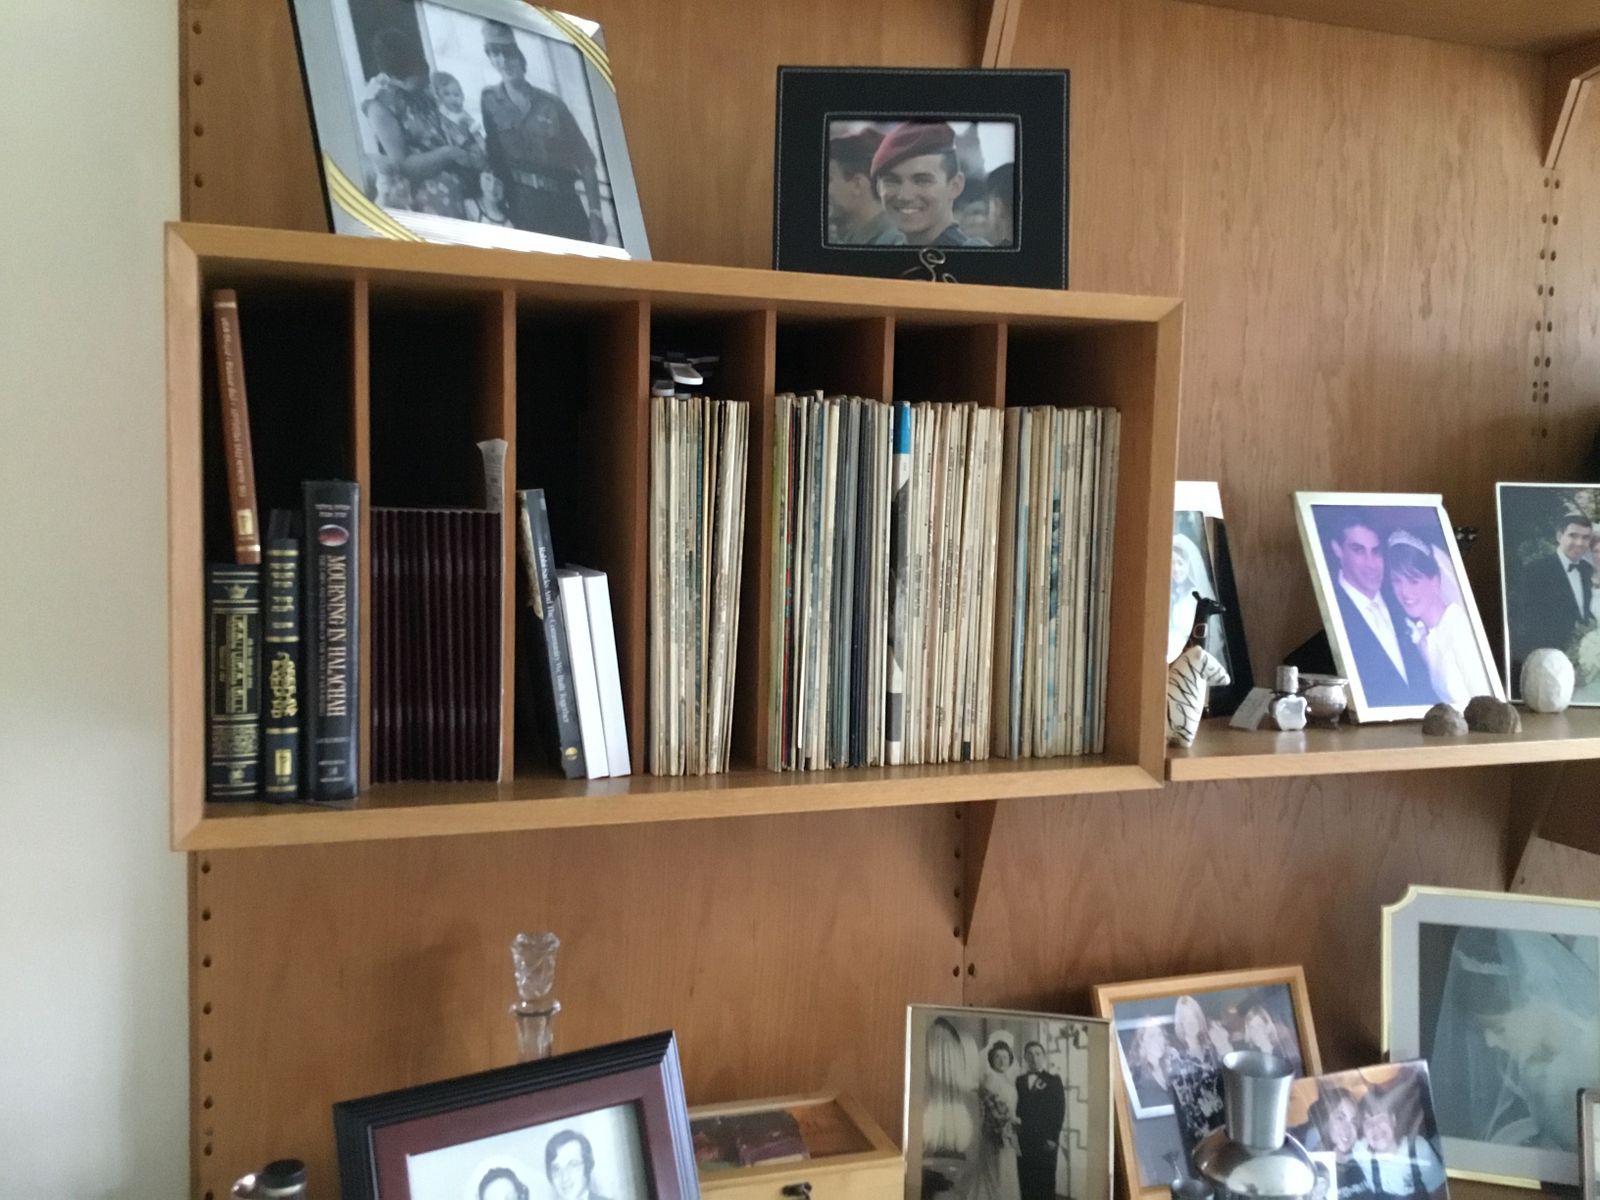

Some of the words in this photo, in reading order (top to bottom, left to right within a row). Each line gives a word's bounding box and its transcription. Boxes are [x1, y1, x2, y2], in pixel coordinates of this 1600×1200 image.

[327, 555, 347, 625] MOURNING
[546, 606, 555, 618] The
[327, 628, 347, 642] IN
[548, 619, 561, 661] Community
[327, 646, 347, 717] HALACHAH
[559, 693, 570, 723] Together
